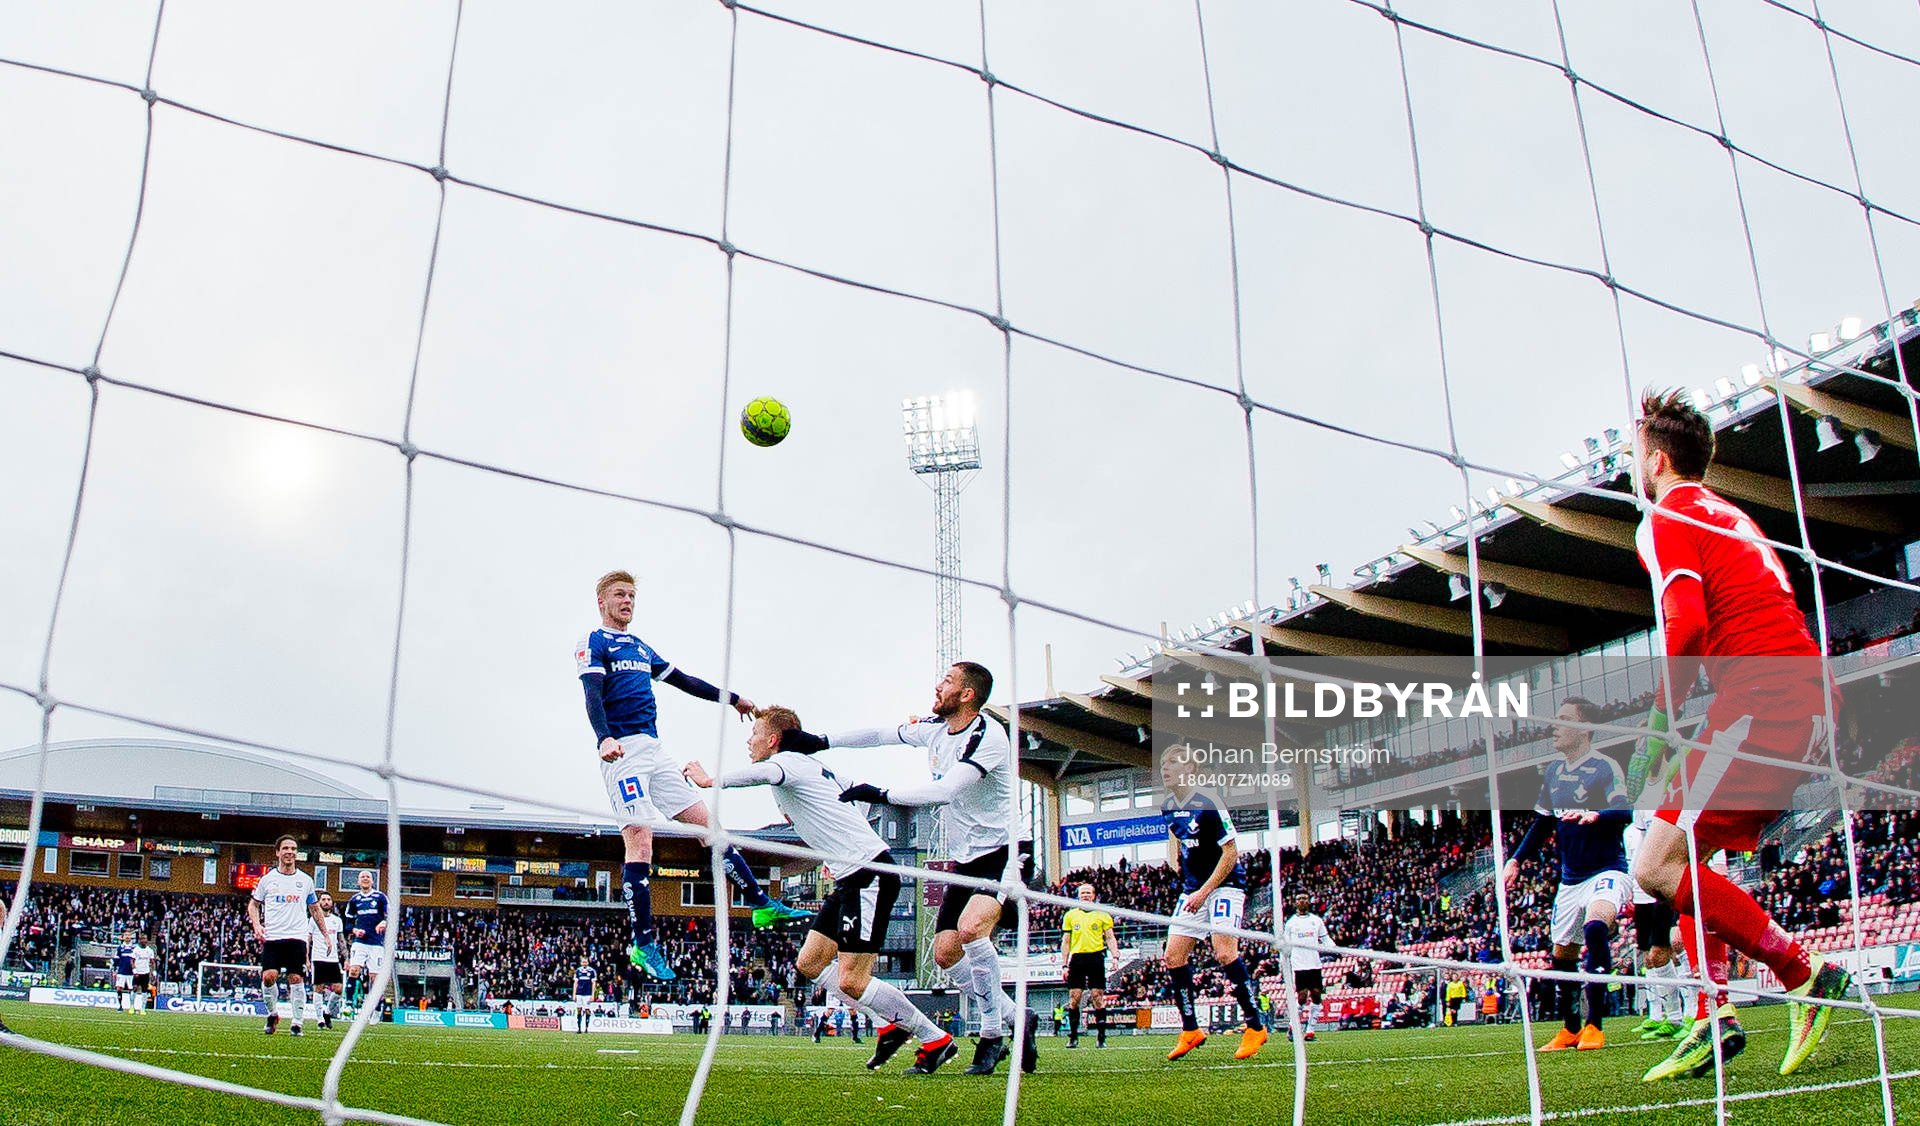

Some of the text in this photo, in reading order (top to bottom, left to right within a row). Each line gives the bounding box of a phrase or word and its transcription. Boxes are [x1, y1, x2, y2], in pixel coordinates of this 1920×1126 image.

[71, 835, 125, 849] SHARP
[1065, 823, 1168, 847] NA Familjeläktare
[53, 990, 118, 1006] Swegon
[166, 997, 257, 1015] Caverion
